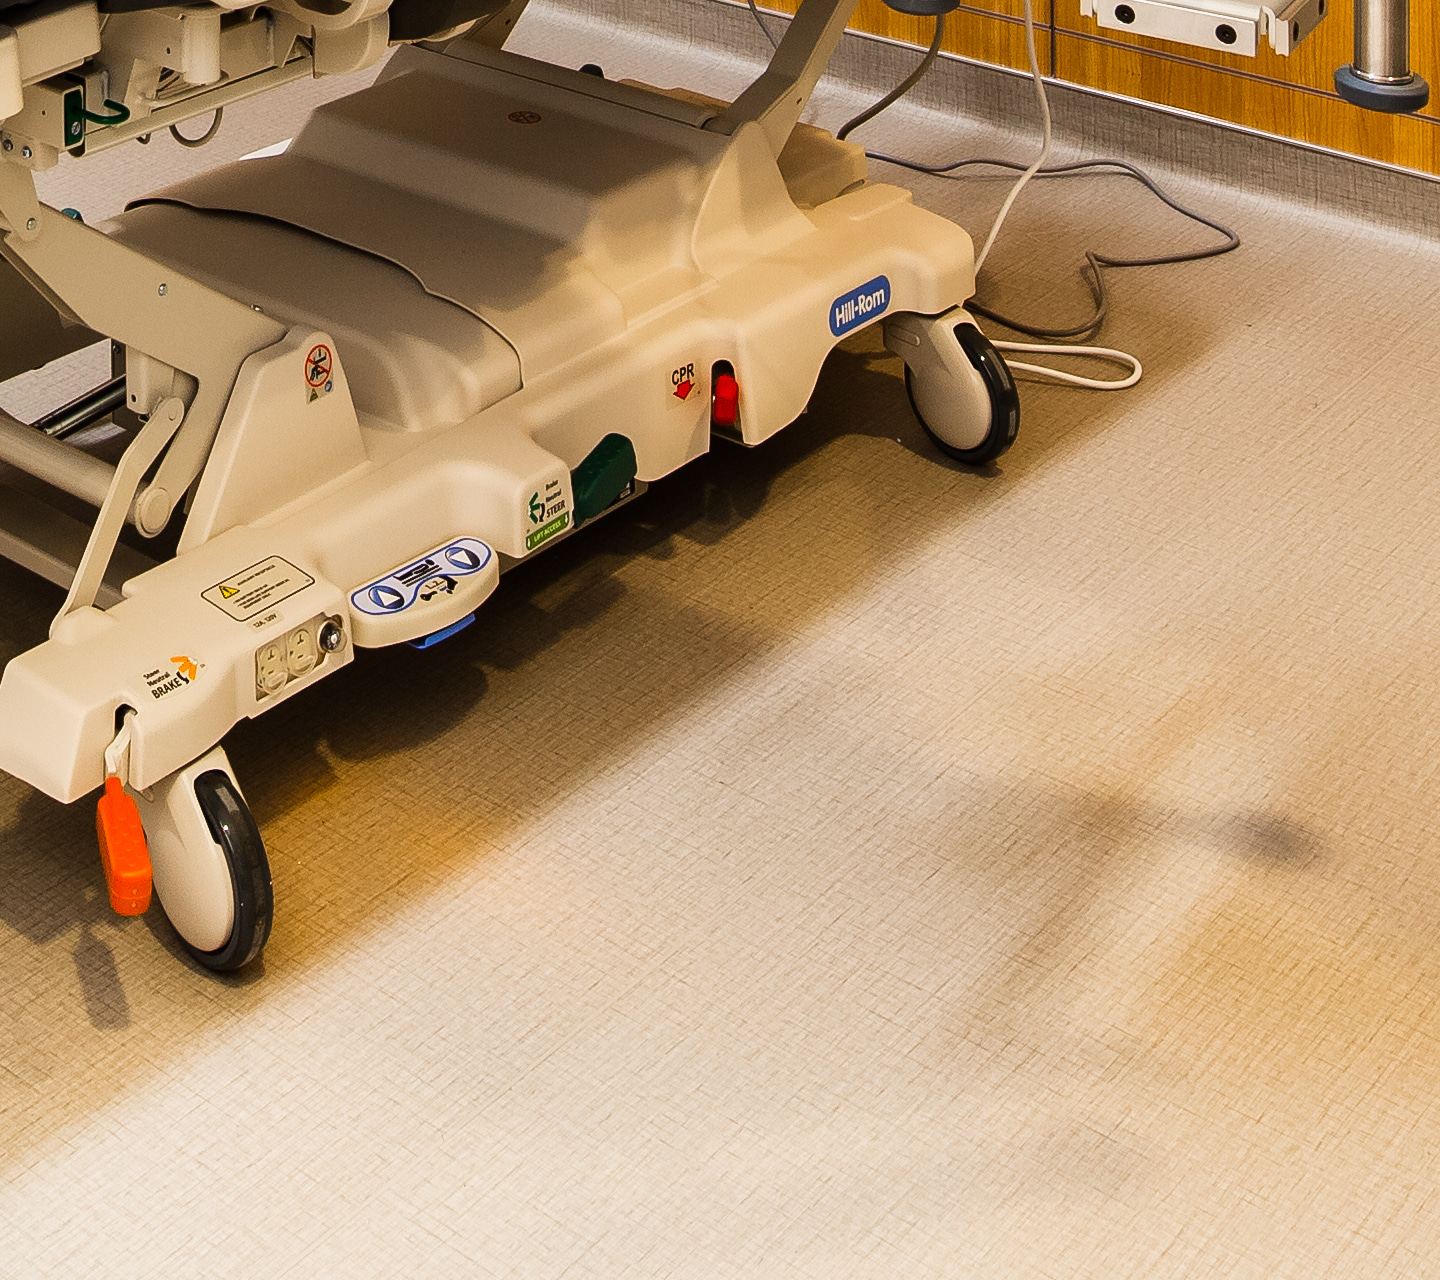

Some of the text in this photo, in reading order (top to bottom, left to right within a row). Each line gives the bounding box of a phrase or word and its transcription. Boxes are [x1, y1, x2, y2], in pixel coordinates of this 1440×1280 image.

[835, 288, 885, 328] Hill-Rom
[672, 363, 695, 385] CPR
[546, 500, 566, 518] STEER
[151, 678, 183, 699] BRAKE
